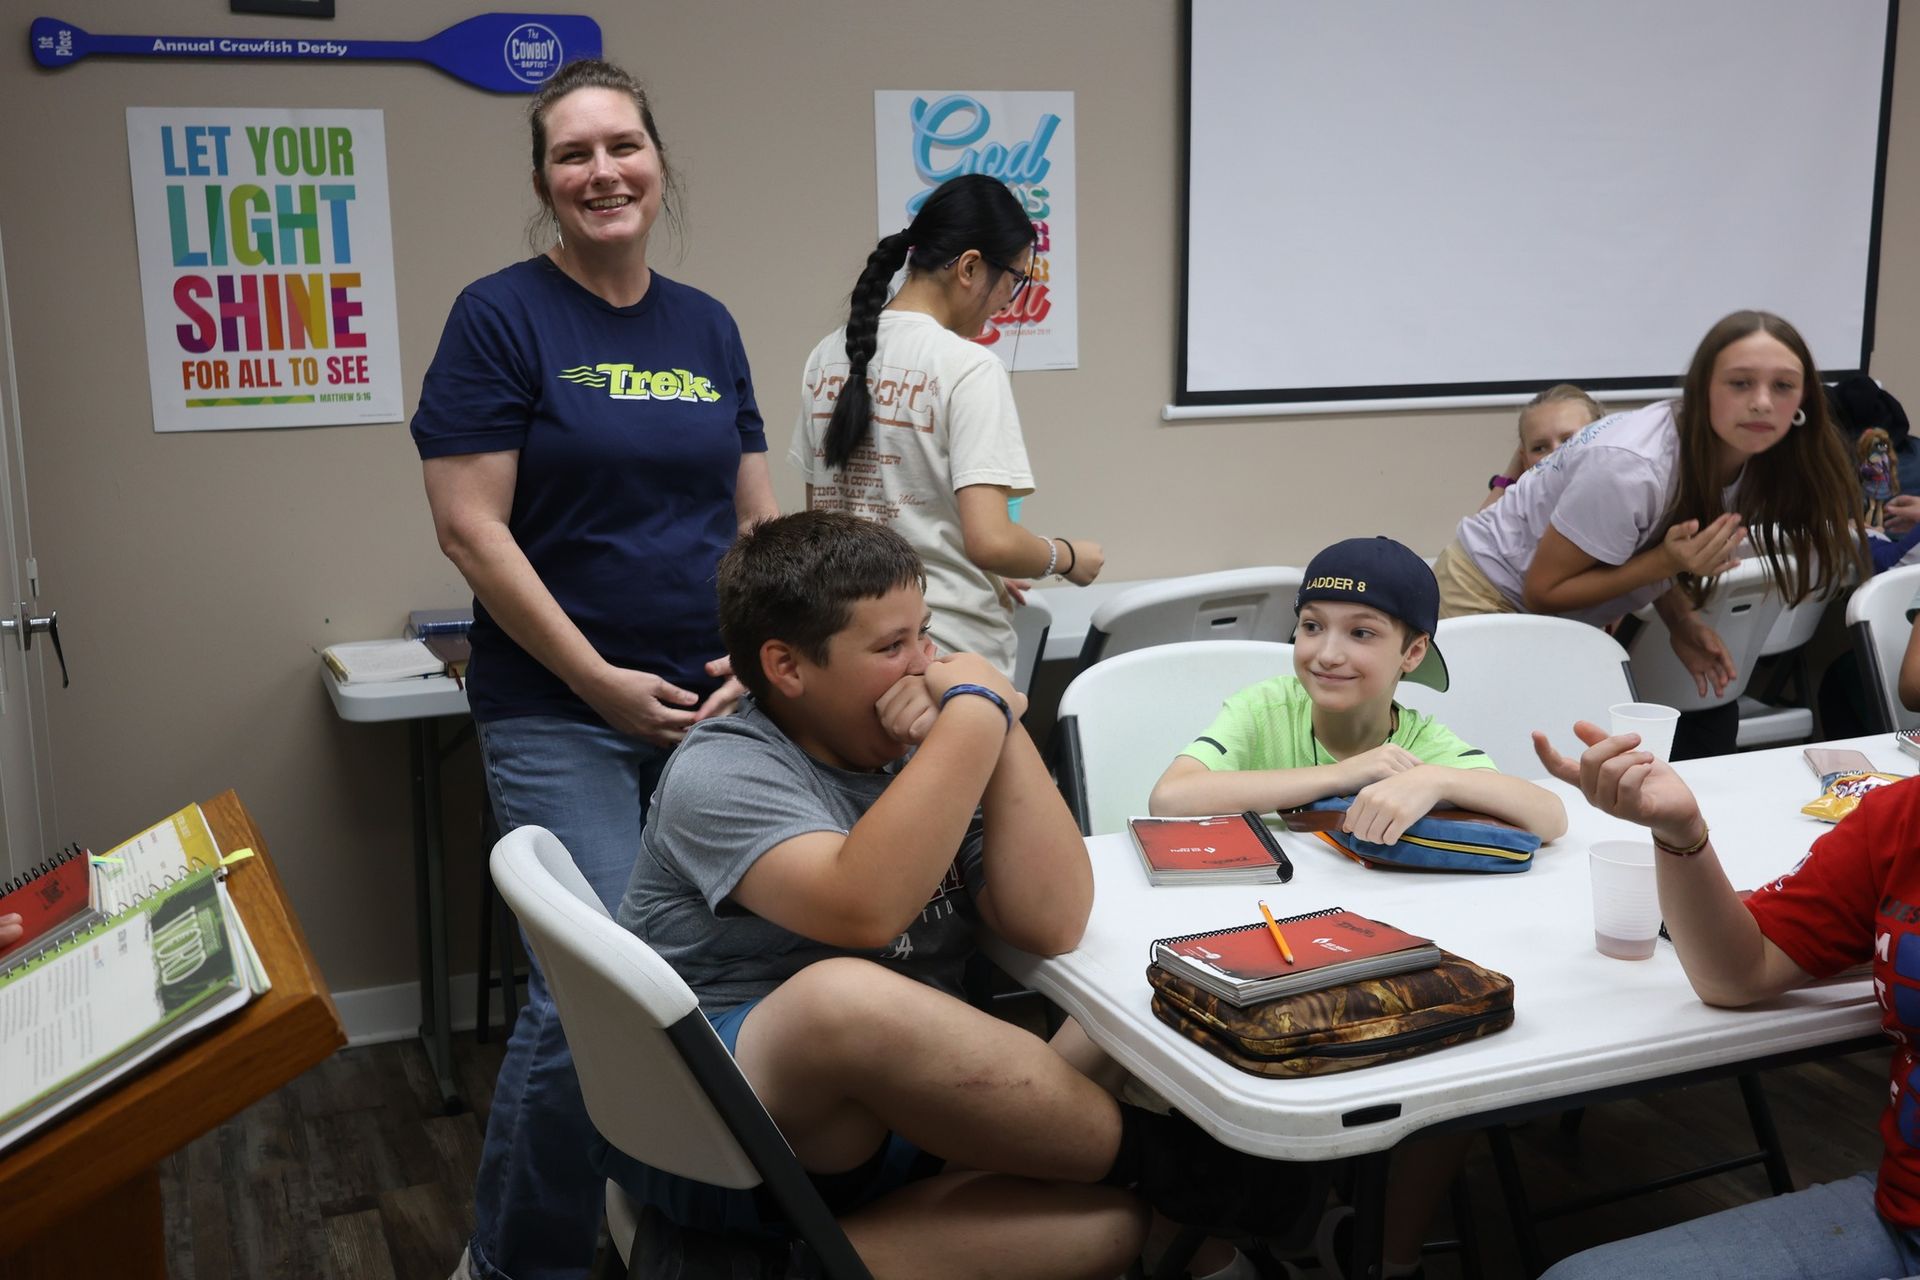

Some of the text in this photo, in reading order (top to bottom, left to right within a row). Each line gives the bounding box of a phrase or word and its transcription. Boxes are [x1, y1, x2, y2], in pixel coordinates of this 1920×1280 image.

[38, 36, 54, 49] 1st
[55, 30, 73, 56] Place
[152, 39, 347, 56] Annual Crawfish Derby
[527, 28, 540, 39] The
[512, 38, 555, 61] COWBOY
[161, 125, 354, 176] LET YOUR
[910, 94, 1061, 186] God
[166, 184, 356, 267] LIGHT
[173, 272, 367, 354] SHINE
[182, 355, 370, 390] FOR ALL TO SEE
[595, 363, 722, 402] Trek
[320, 392, 371, 403] MATTHEW 5:16
[1306, 577, 1366, 592] LADDER 8
[153, 905, 207, 986] WORD
